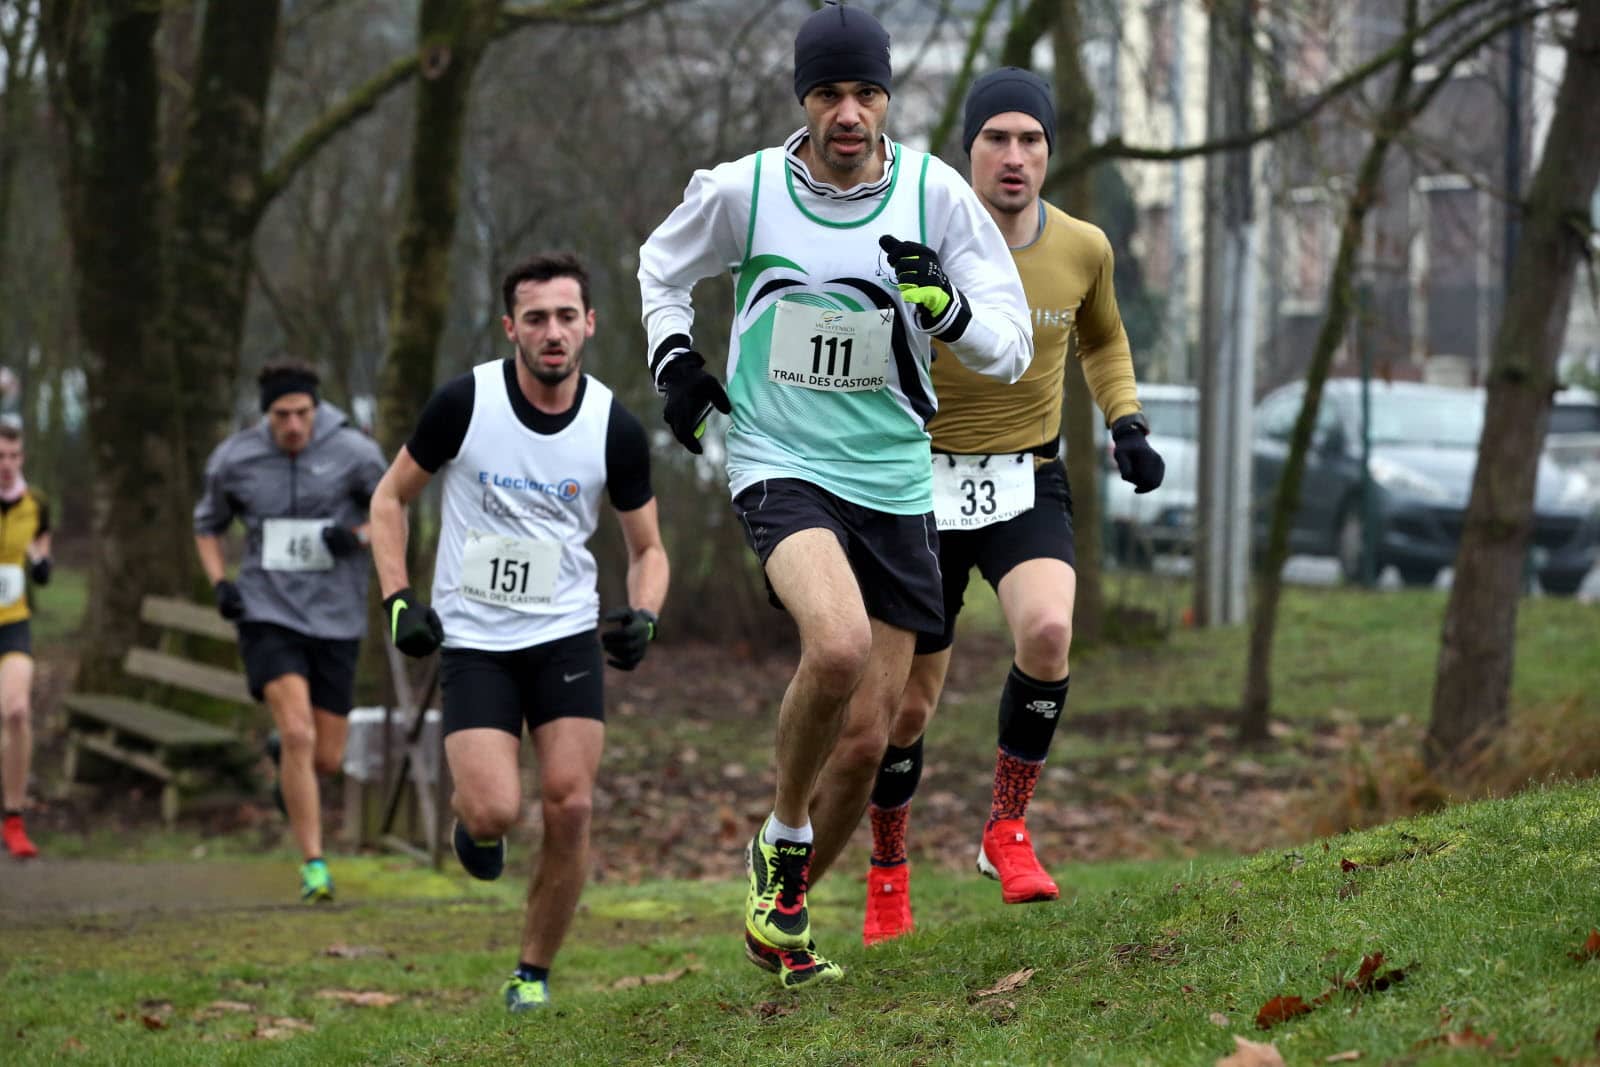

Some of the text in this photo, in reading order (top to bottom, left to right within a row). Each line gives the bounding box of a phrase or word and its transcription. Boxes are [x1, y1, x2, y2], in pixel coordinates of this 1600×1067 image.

[810, 335, 853, 376] 111
[773, 370, 884, 388] TRAIL DES CASTORS
[479, 471, 557, 495] E Leclerc
[960, 478, 997, 517] 33
[490, 557, 530, 594] 151
[463, 585, 551, 604] TRAIL DES CASTORS
[779, 846, 807, 856] FILA
